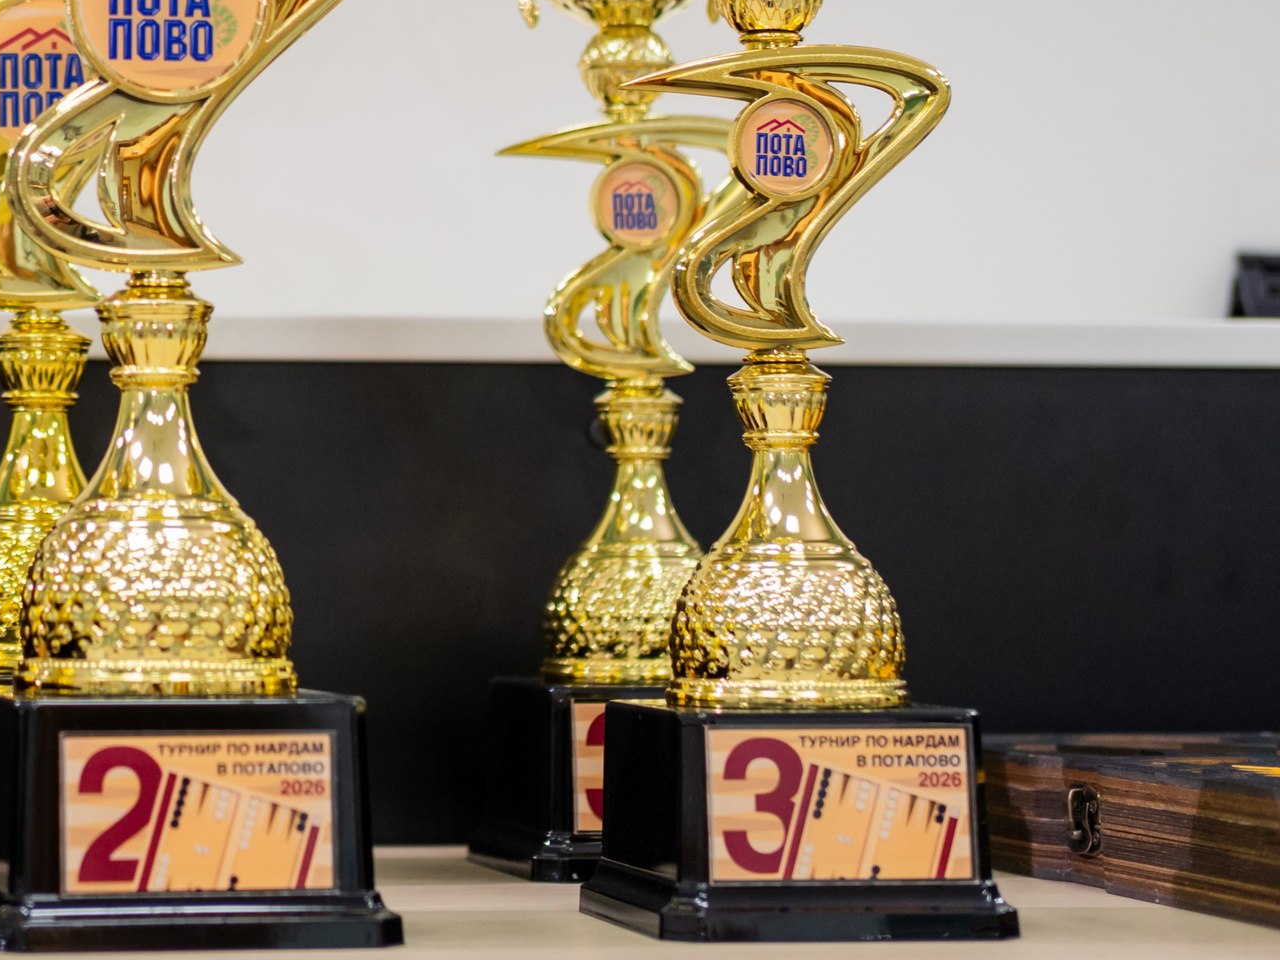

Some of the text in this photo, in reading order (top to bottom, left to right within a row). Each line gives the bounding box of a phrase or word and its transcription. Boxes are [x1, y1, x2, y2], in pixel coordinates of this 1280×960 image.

[108, 18, 214, 62] ПОВО
[0, 91, 64, 127] ПО
[756, 133, 806, 156] ПОТА
[756, 155, 807, 177] ПОВО
[612, 193, 656, 212] ПОТА
[613, 212, 658, 230] ПОВО
[158, 742, 324, 755] ТУРНИР ПО НАРДАМ
[799, 735, 960, 749] ТУРНИР ПО НАРДАМ
[217, 762, 325, 775] В ПОТАПОВО
[857, 754, 961, 767] В ПОТАПОВО
[281, 778, 326, 796] 2026
[918, 771, 962, 788] 2026
[77, 745, 164, 882] 2
[721, 736, 804, 874] 3
